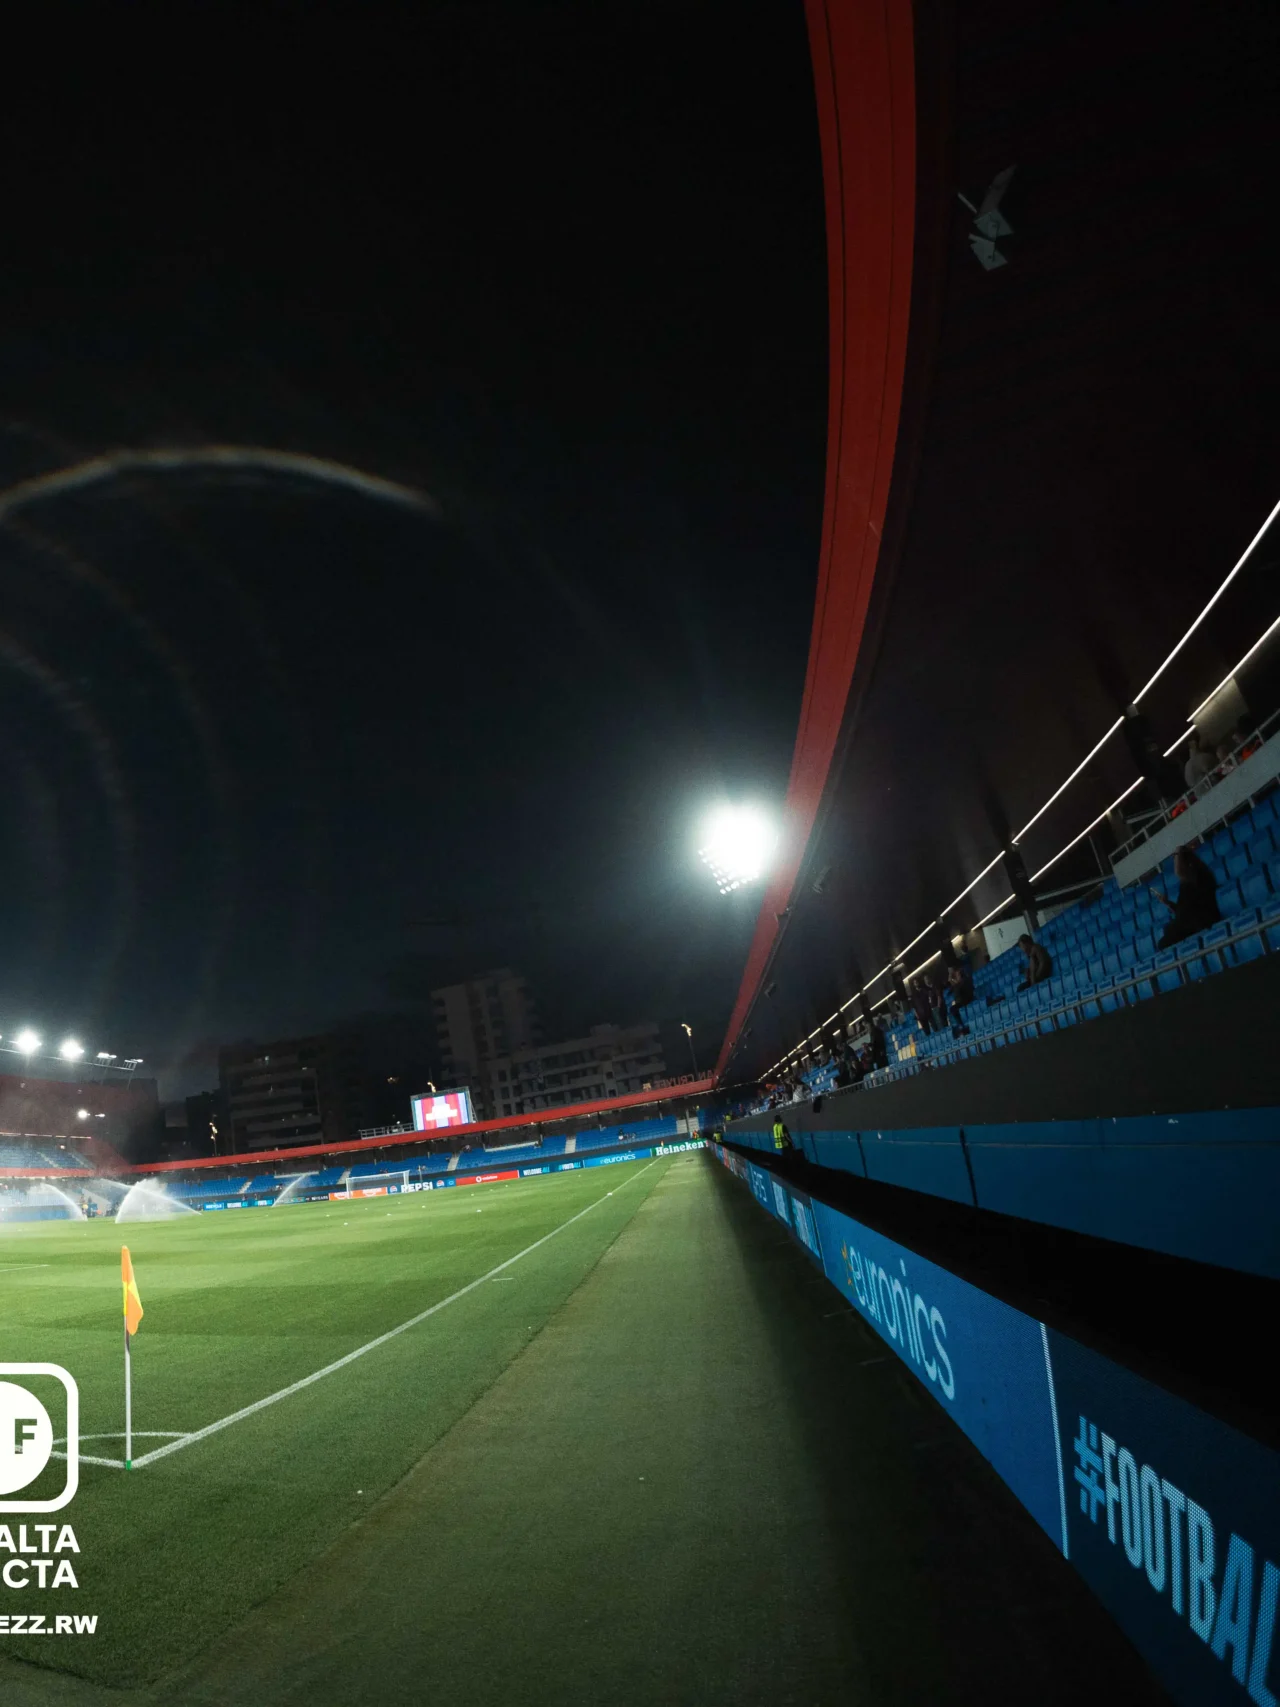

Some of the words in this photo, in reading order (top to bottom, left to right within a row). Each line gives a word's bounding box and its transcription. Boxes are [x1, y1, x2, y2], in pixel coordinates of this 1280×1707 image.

[655, 1140, 704, 1156] Heineken
[603, 1152, 636, 1164] euronics
[401, 1182, 433, 1193] PEPSI
[850, 1246, 955, 1401] euronics
